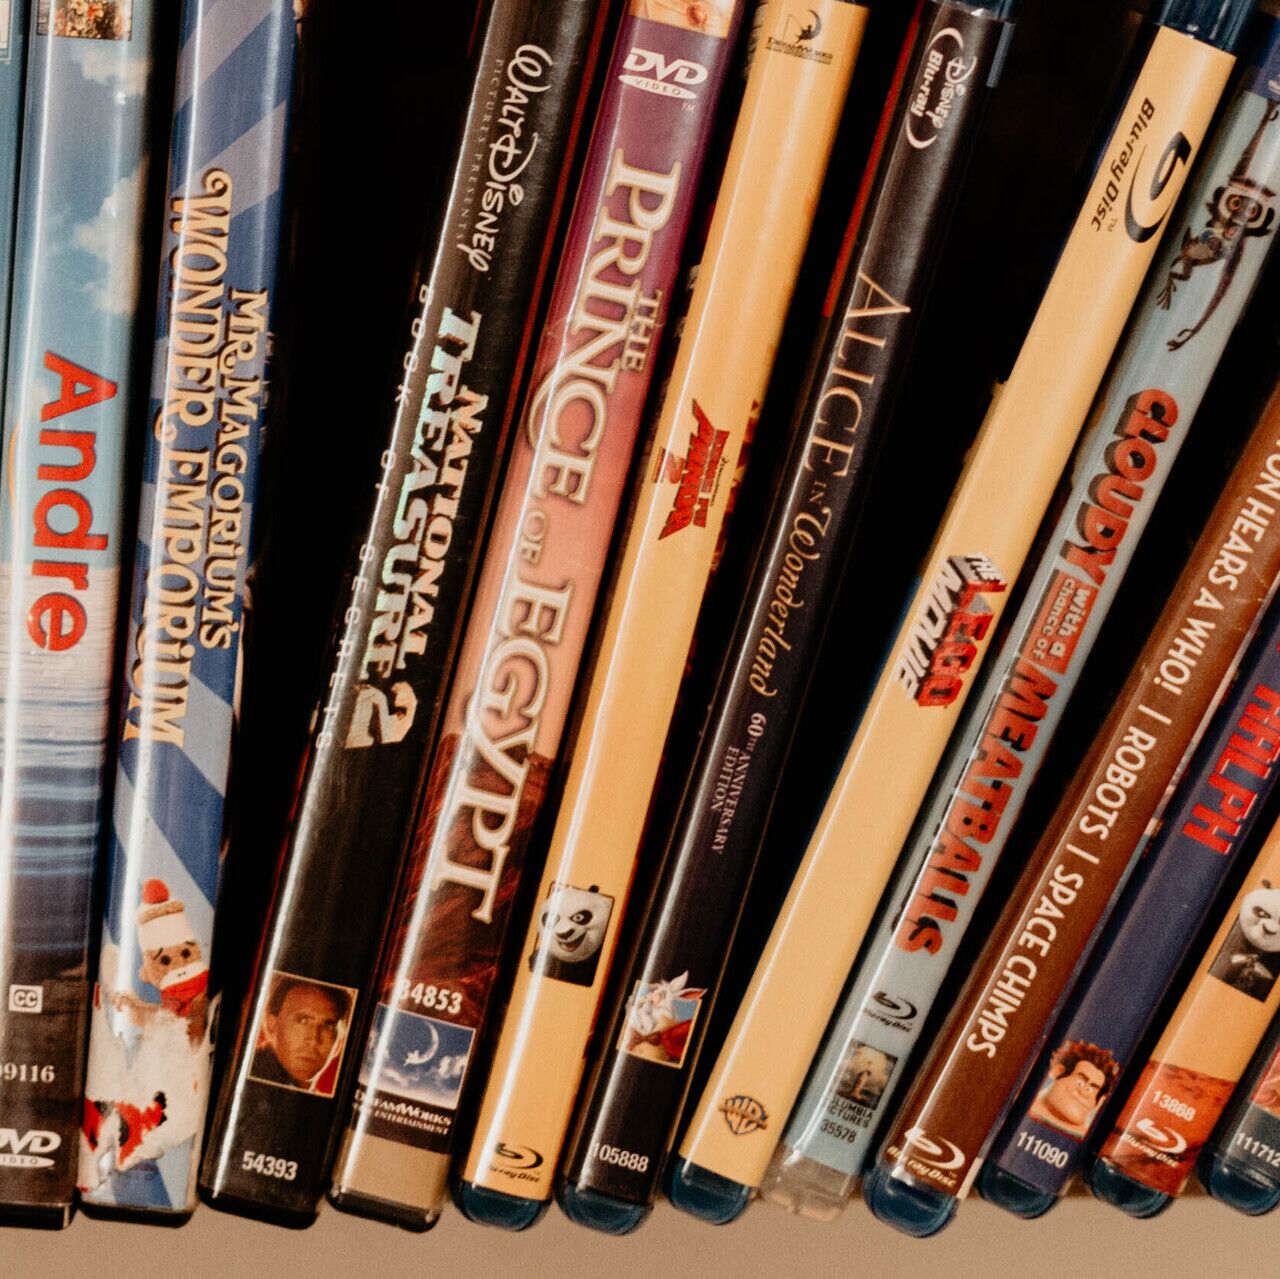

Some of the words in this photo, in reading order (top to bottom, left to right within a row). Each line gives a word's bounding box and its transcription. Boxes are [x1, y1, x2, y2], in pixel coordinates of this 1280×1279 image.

[476, 55, 507, 147] PICTURES
[621, 47, 709, 85] DVD
[909, 50, 944, 116] Blu-ray
[1109, 97, 1156, 192] Blu-ray
[454, 147, 484, 242] PRESENTS
[1090, 181, 1121, 232] Disc
[155, 169, 233, 443] WONDER
[394, 282, 434, 408] BOOK
[527, 147, 681, 505] PRINCE
[624, 289, 666, 374] THE
[807, 271, 913, 479] ALICE
[26, 351, 118, 652] Andre
[198, 376, 263, 650] MAGORIUM'S
[358, 308, 483, 681] TREASURE
[653, 447, 684, 486] 2
[806, 479, 827, 503] IN
[1059, 389, 1179, 585] CLOUDY
[393, 383, 490, 670] NATIONAL
[519, 509, 548, 565] OF
[1208, 495, 1276, 591] HEARS
[123, 447, 212, 746] EMPORIUM
[748, 497, 834, 698] Wonderland
[894, 556, 963, 702] MOVIE
[1041, 578, 1076, 637] chance
[1058, 586, 1093, 638] with
[1193, 586, 1225, 610] A
[1032, 637, 1049, 661] of
[1048, 638, 1066, 658] a
[1152, 613, 1217, 695] WHO!
[345, 679, 418, 750] 2
[428, 568, 574, 924] EGYPT
[710, 745, 740, 814] EDITION
[710, 752, 754, 855] ANNIVERSARY
[894, 651, 1058, 957] MEATBALLS
[1078, 723, 1158, 841] ROBOTS
[1017, 862, 1085, 958] SPACE
[13, 989, 40, 1010] CC
[966, 949, 1038, 1059] CHIMPS
[241, 1150, 297, 1182] 54393
[590, 1141, 650, 1174] 105888
[927, 1168, 958, 1188] Disc
[1018, 1130, 1069, 1169] 111090
